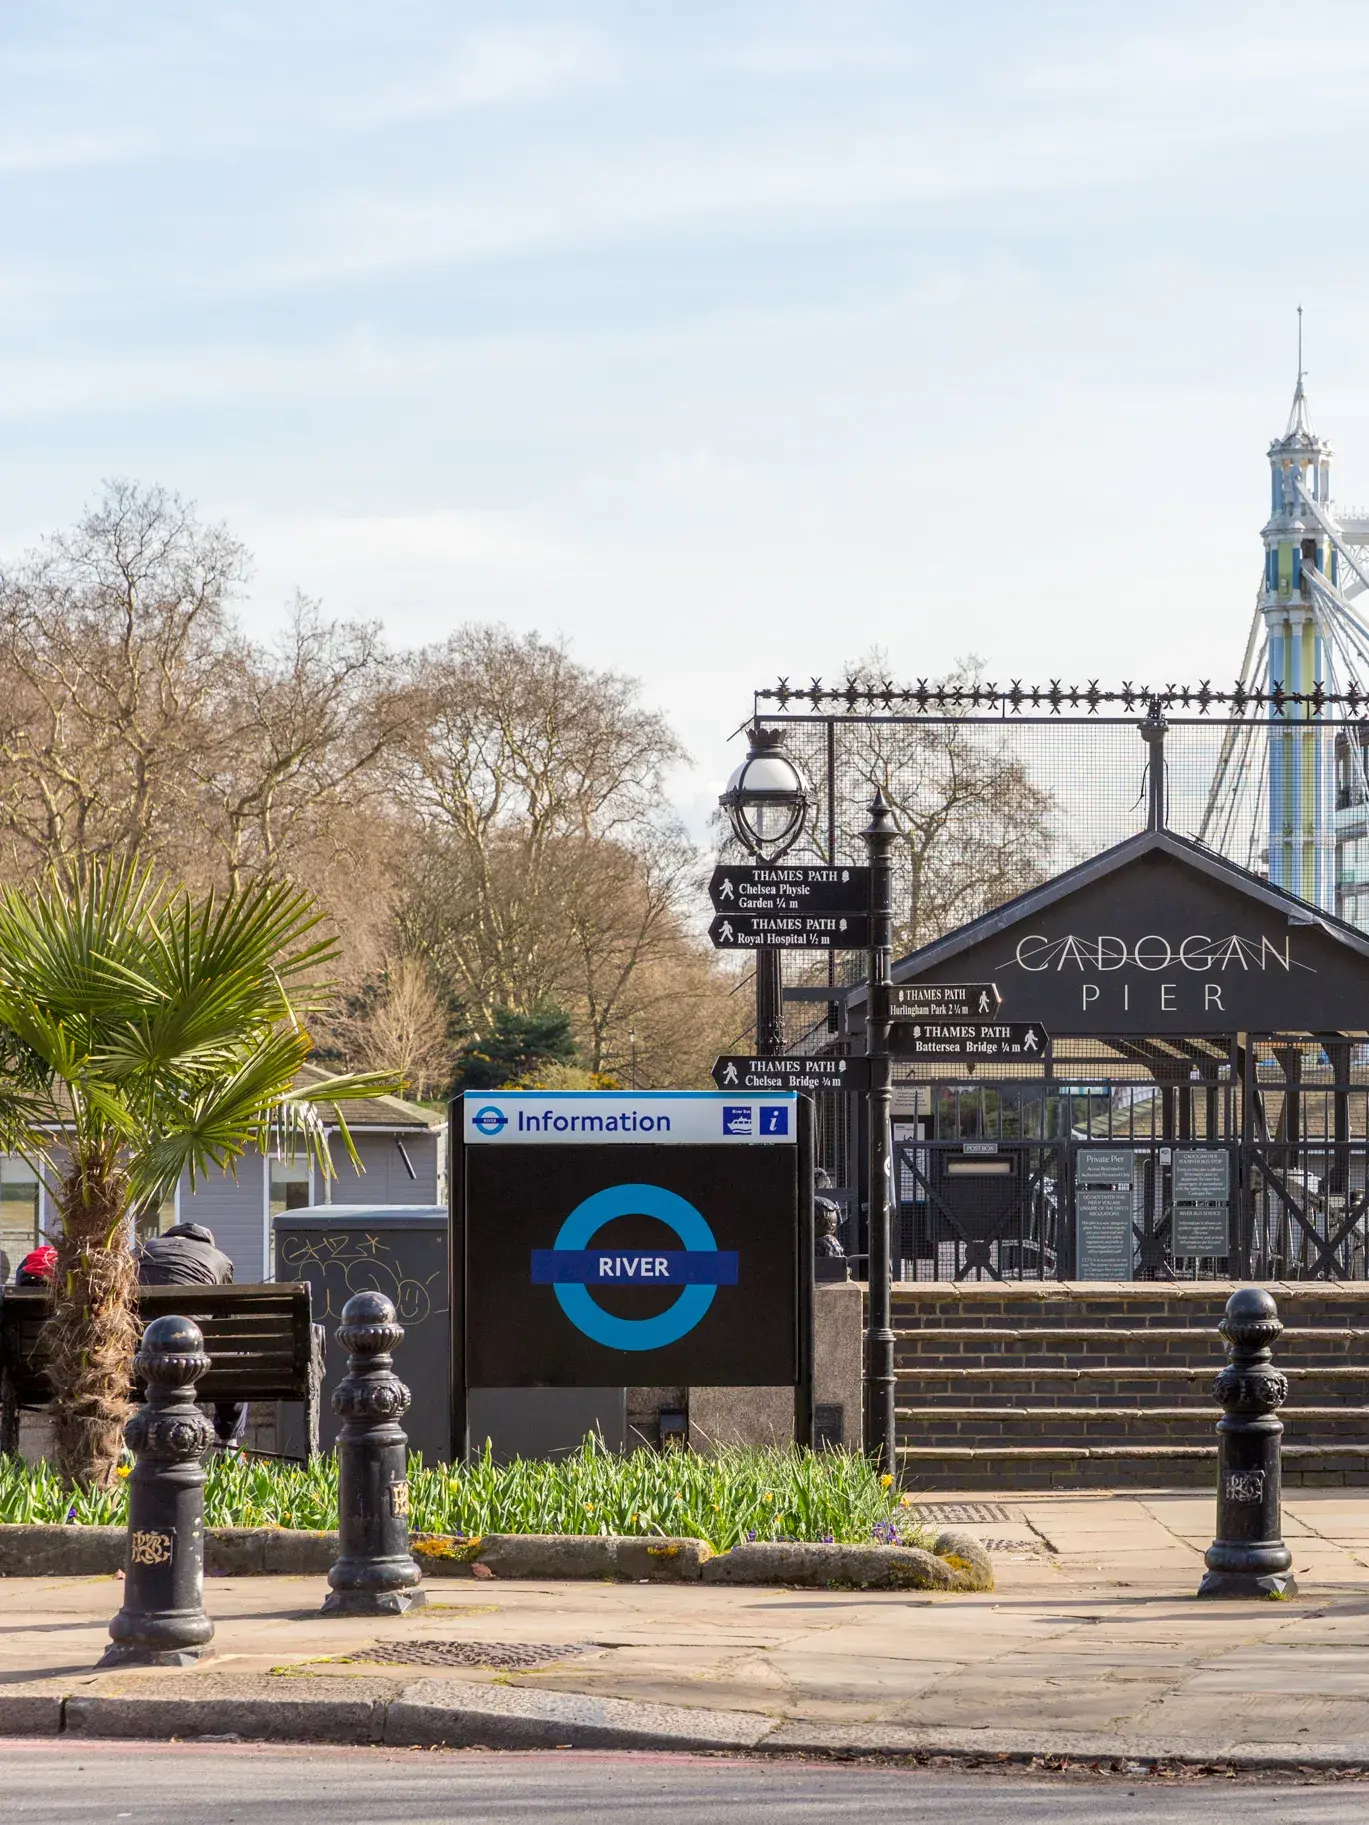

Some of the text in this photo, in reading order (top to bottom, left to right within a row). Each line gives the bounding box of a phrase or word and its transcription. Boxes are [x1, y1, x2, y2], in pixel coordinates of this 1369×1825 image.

[752, 870, 838, 882] THAMES PATH
[738, 883, 810, 897] Chelsea Physic
[738, 898, 773, 908] Garden
[790, 900, 798, 909] m
[751, 918, 836, 930] THAMES PATH
[737, 933, 764, 945] Royal
[766, 933, 806, 946] Hospital
[821, 936, 830, 944] m
[1016, 934, 1290, 972] CADOGAN
[906, 989, 966, 1000] THAMES PATH
[1082, 984, 1226, 1011] PIER
[890, 1004, 929, 1017] Hurlingham
[930, 1004, 946, 1015] Park
[924, 1026, 1011, 1038] THAMES PATH
[915, 1041, 960, 1052] Battersea
[966, 1042, 998, 1054] Bridge
[1012, 1044, 1021, 1052] m
[749, 1061, 836, 1072] THAMES PATH
[745, 1075, 782, 1086] Chelsea
[788, 1076, 820, 1088] Bridge
[518, 1110, 671, 1132] Information
[599, 1257, 670, 1276] RIVER
